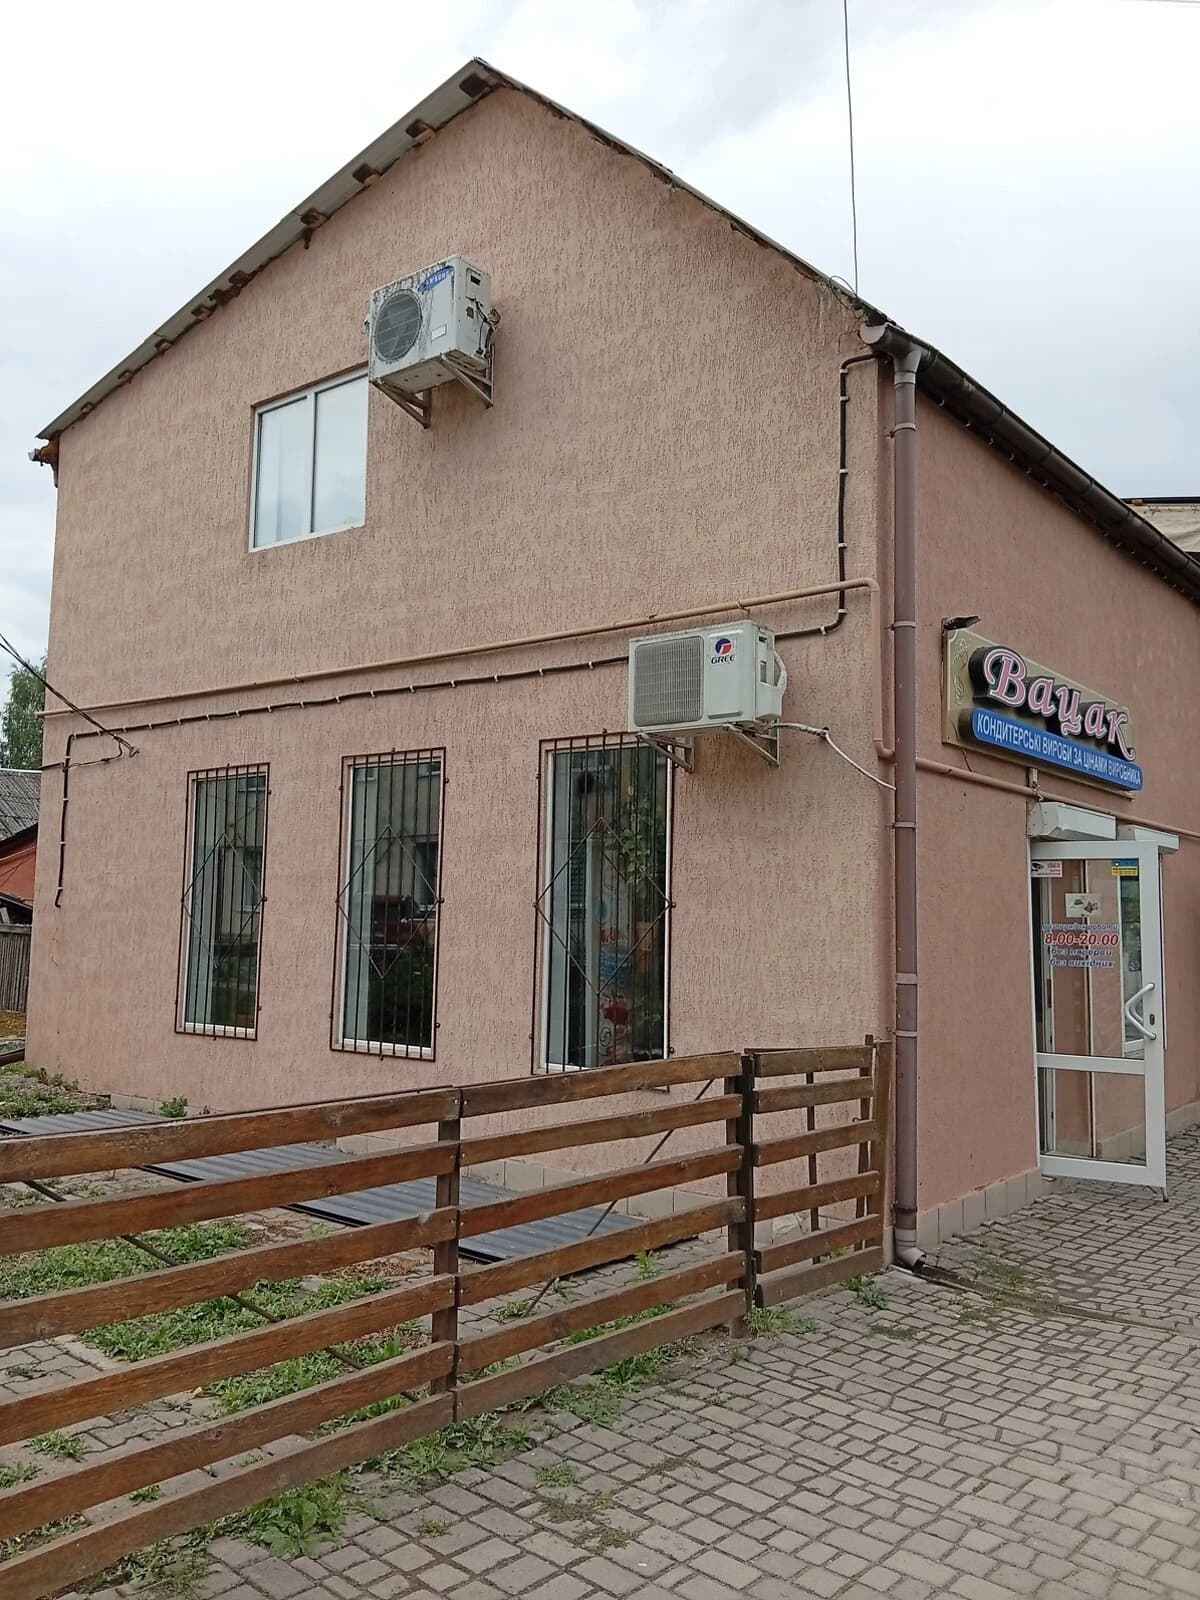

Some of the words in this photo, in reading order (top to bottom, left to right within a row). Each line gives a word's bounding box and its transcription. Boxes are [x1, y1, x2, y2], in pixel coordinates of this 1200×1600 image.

[711, 654, 736, 665] GREE
[981, 647, 1136, 762] Вацак
[977, 712, 1041, 752] КОНДИТЕРСЬКІ
[1042, 737, 1073, 763] ВИРОБИ
[1073, 748, 1083, 766] ЗА
[1084, 752, 1108, 775] ЦІНАМИ
[1108, 760, 1141, 785] ВИРОБНИКА
